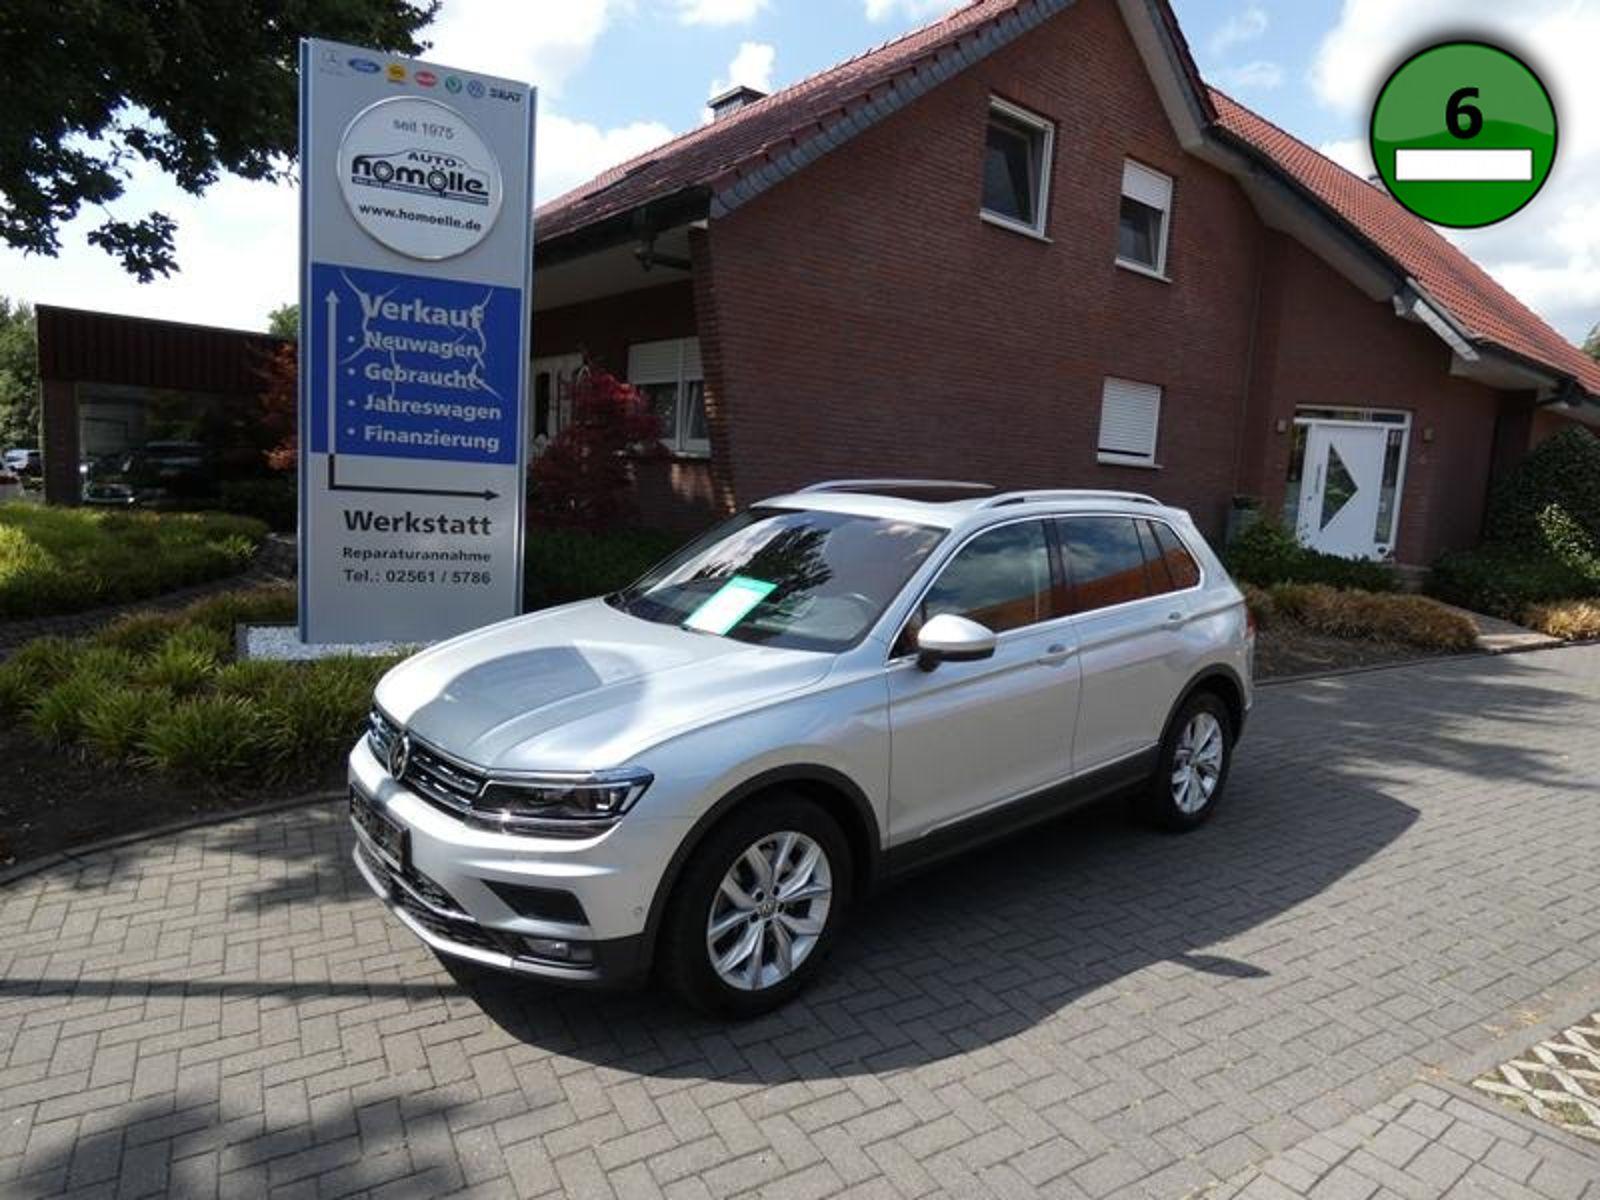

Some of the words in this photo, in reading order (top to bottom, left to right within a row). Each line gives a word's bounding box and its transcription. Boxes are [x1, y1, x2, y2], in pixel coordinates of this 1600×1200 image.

[393, 119, 417, 132] seit
[421, 121, 455, 140] 1975
[359, 204, 482, 232] www.homoelle.de
[362, 293, 485, 329] Verkauf
[364, 331, 481, 358] Neuwagen
[364, 395, 502, 423] Jahreswagen
[365, 424, 500, 453] Finanzierung
[344, 509, 492, 536] Werkstatt
[343, 546, 491, 562] Reparaturannahme
[344, 569, 380, 584] Tel.:
[386, 569, 436, 584] 02561
[452, 571, 492, 585] 5786
